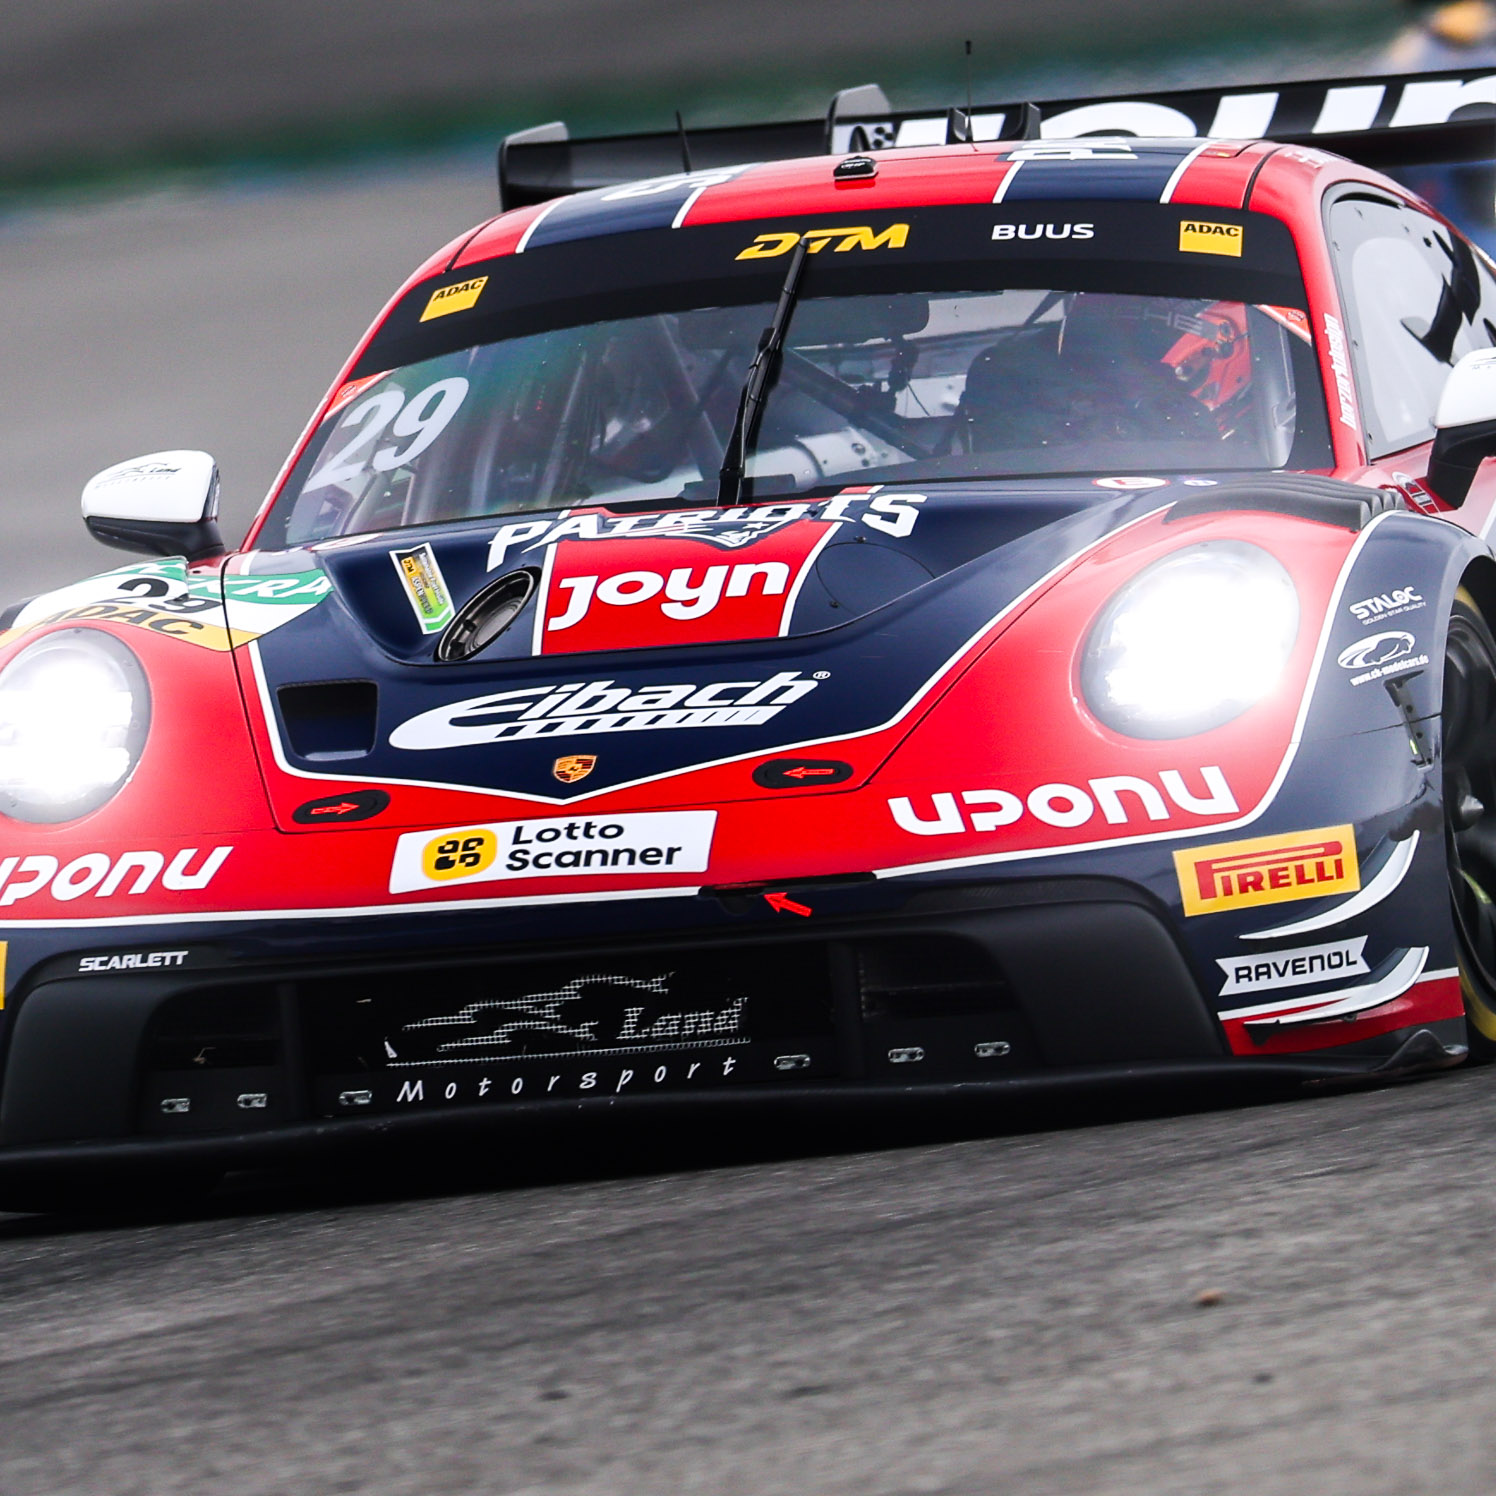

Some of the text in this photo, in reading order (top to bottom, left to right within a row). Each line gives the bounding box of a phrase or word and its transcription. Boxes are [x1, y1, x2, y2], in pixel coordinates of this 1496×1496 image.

[734, 222, 911, 261] DTM
[990, 222, 1095, 241] BUUS
[1183, 222, 1240, 238] ADAC
[432, 278, 485, 302] ADAC
[301, 376, 470, 494] 29
[485, 492, 929, 573] PATRIOTS
[547, 561, 790, 632] joyn
[1349, 585, 1423, 620] STALOC
[388, 670, 818, 751] Eibach
[511, 819, 625, 846] Lotto
[505, 841, 683, 872] Scanner
[1194, 840, 1345, 901] PIRELLI
[78, 950, 189, 973] SCARLETT
[1234, 949, 1358, 984] RAVENOL
[615, 996, 749, 1041] Land
[397, 1055, 736, 1103] Motorsport
